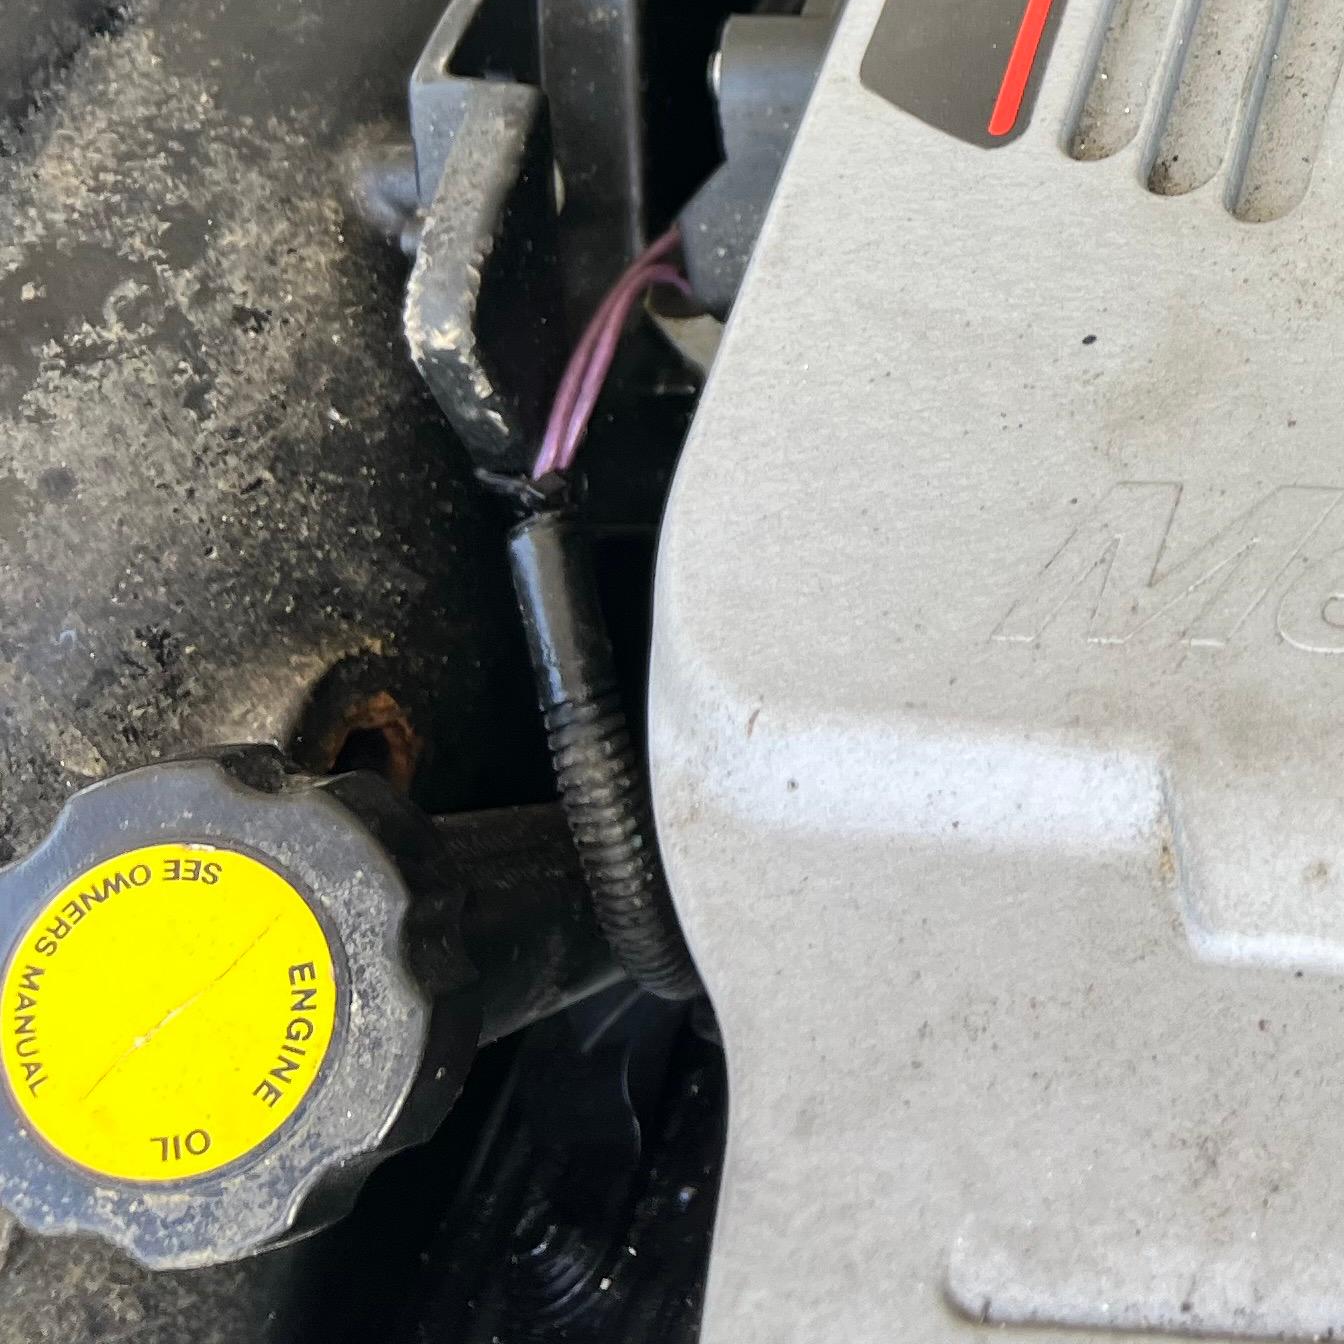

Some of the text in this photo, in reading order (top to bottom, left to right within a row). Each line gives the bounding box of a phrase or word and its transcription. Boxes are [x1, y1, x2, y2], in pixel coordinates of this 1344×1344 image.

[13, 858, 224, 1099] SEE OWNERS MANUAL
[150, 960, 317, 1164] ENGINE OIL
